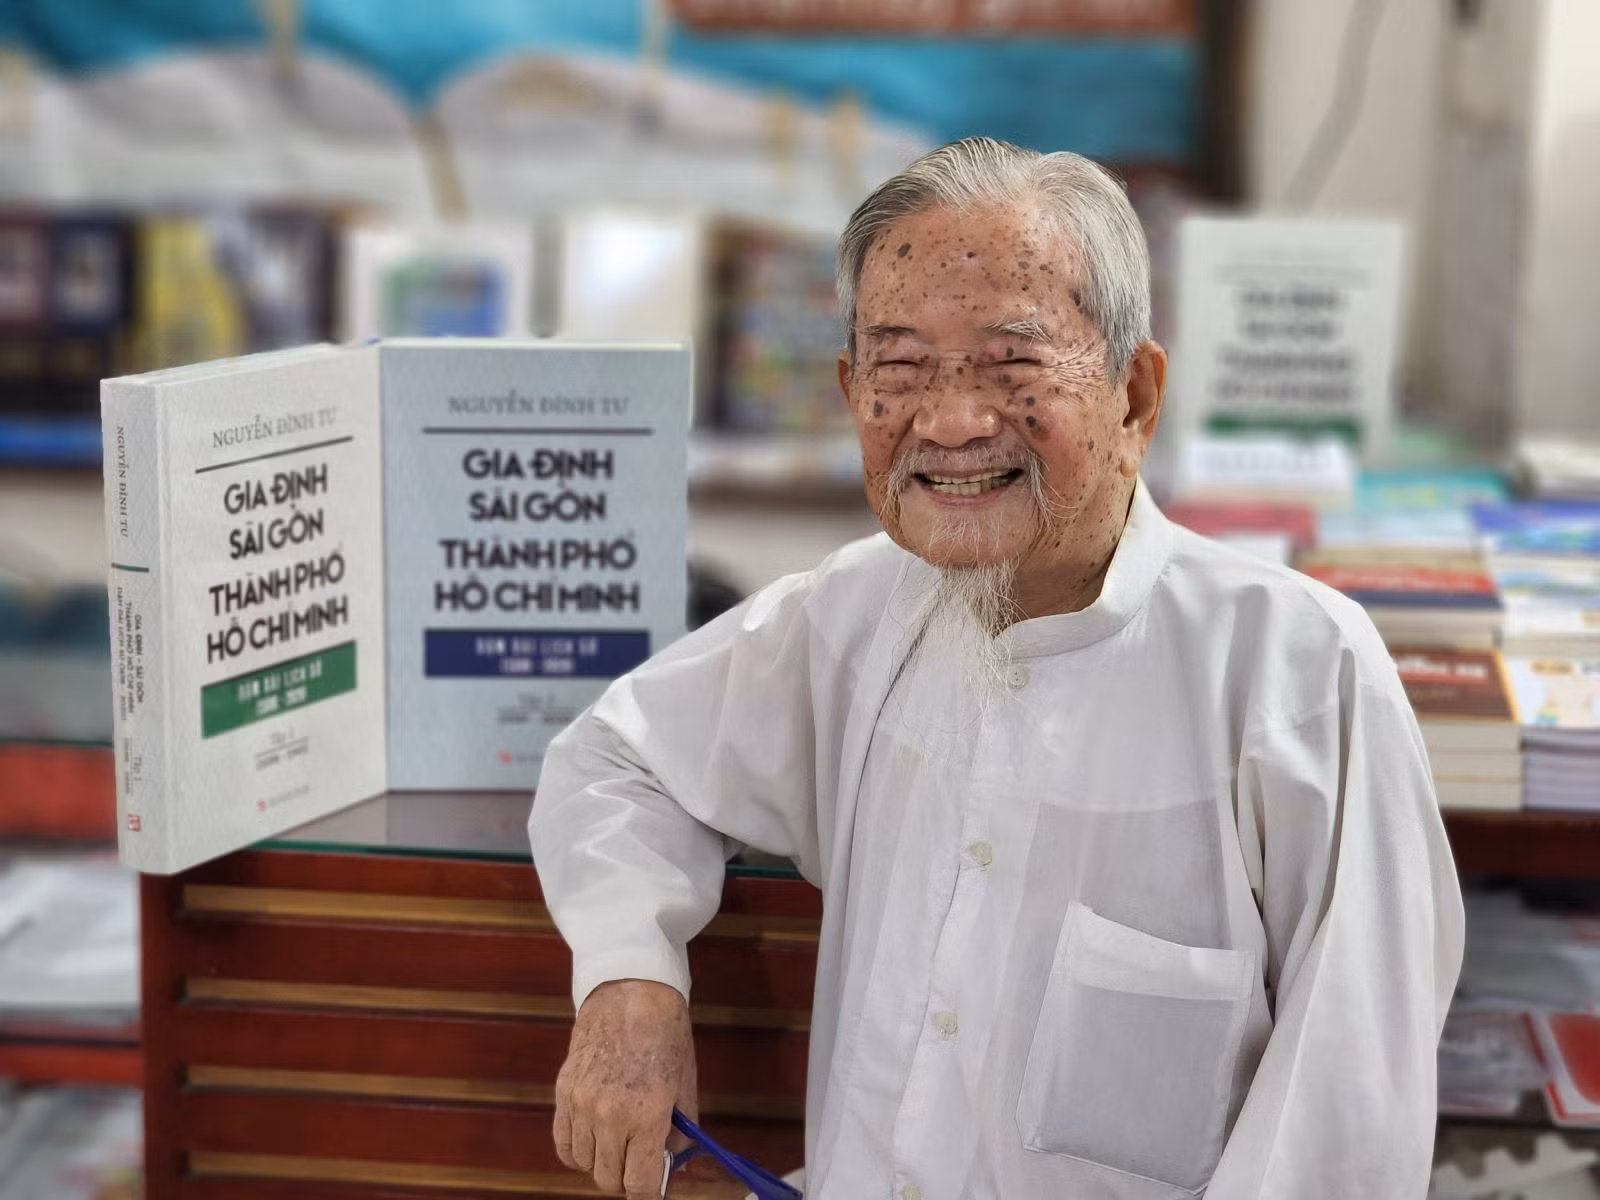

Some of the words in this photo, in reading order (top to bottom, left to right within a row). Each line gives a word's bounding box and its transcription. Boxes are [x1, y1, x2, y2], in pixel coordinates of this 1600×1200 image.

[212, 412, 273, 449] NGUYỄN
[462, 449, 526, 479] GIA
[528, 449, 614, 488] ĐỊNH
[224, 479, 268, 515] GIA
[270, 463, 328, 510] ĐỊNH
[469, 487, 519, 522] SÀI
[229, 520, 264, 560] SÀI
[438, 535, 557, 570] THÀNH
[561, 530, 637, 571] PHỐ
[208, 565, 292, 617] THÀNH
[294, 540, 346, 595] PHỐ
[434, 573, 489, 613] HỒ
[493, 574, 558, 613] CHÍ
[558, 582, 641, 613] MINH
[207, 615, 246, 664] HỒ
[293, 594, 349, 640] MINH
